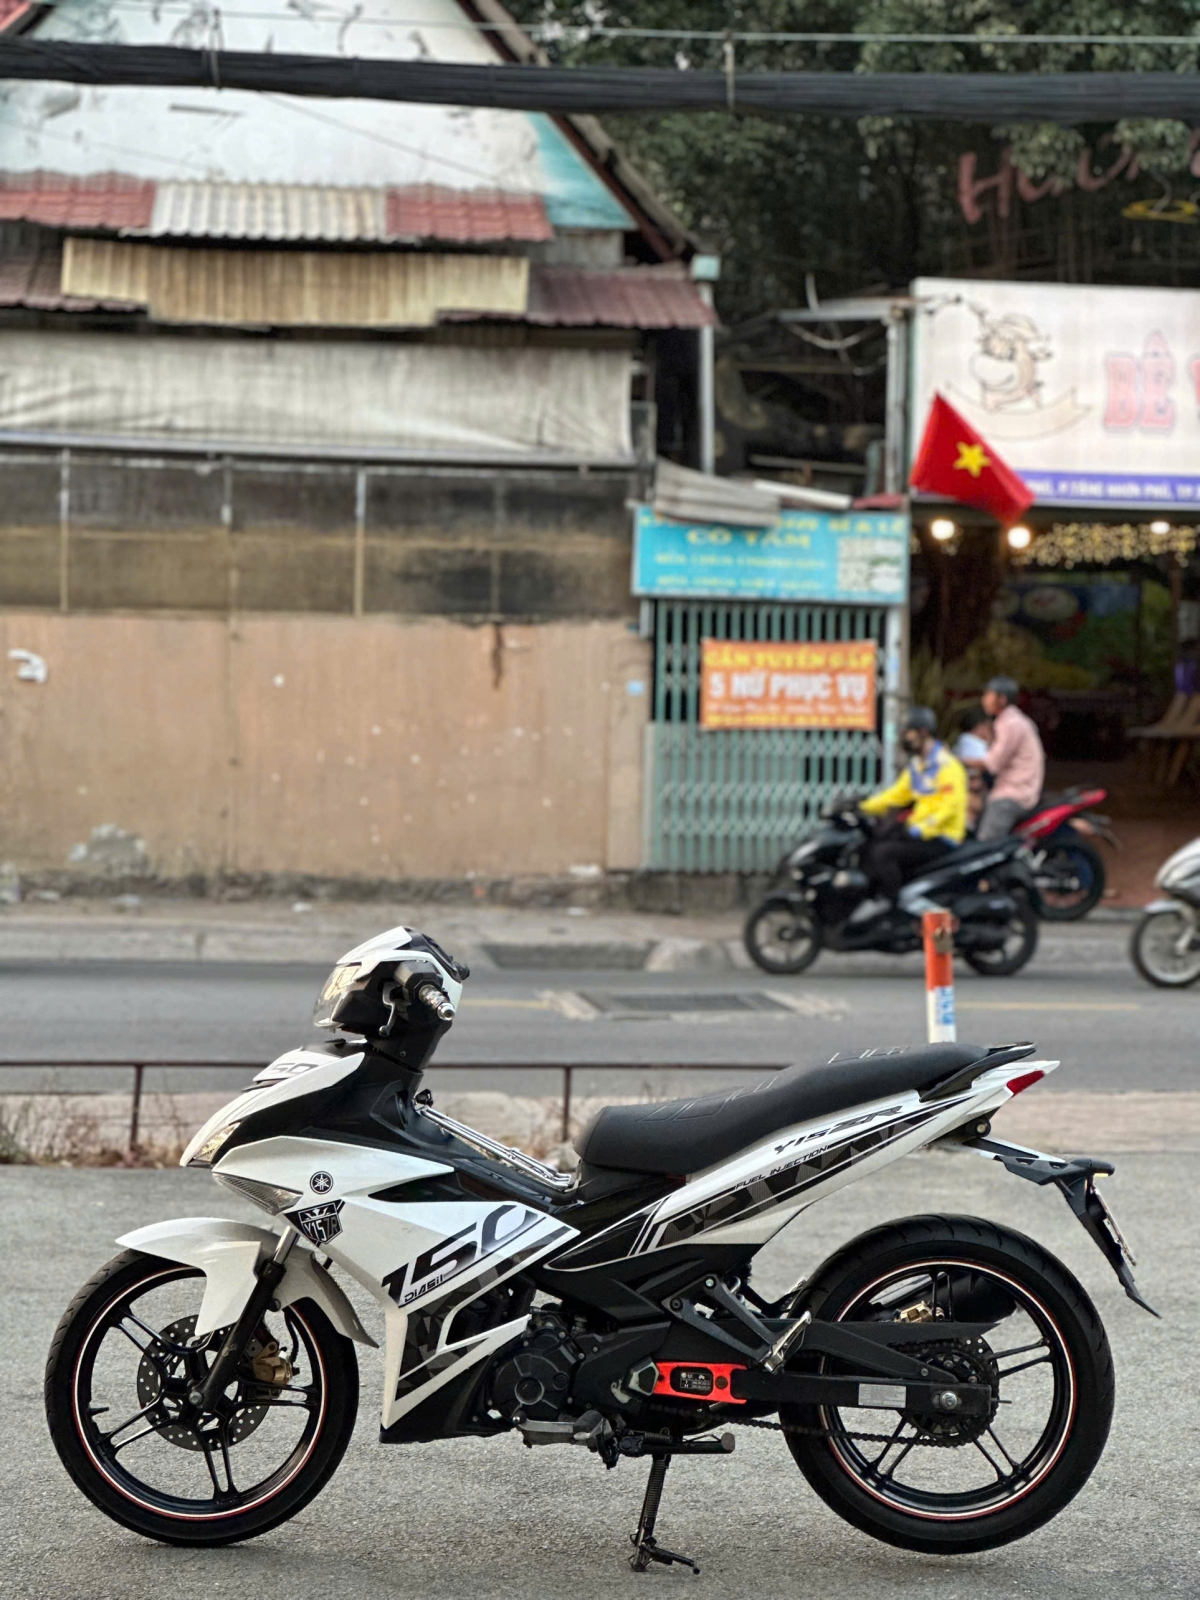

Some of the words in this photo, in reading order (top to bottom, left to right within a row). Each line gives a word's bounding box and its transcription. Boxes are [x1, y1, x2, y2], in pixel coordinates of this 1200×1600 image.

[770, 673, 832, 703] PHỤC
[836, 672, 867, 704] VỤ
[774, 1105, 903, 1155] Y15ZR
[734, 1173, 766, 1190] FUEL
[769, 1144, 829, 1178] INJECTION
